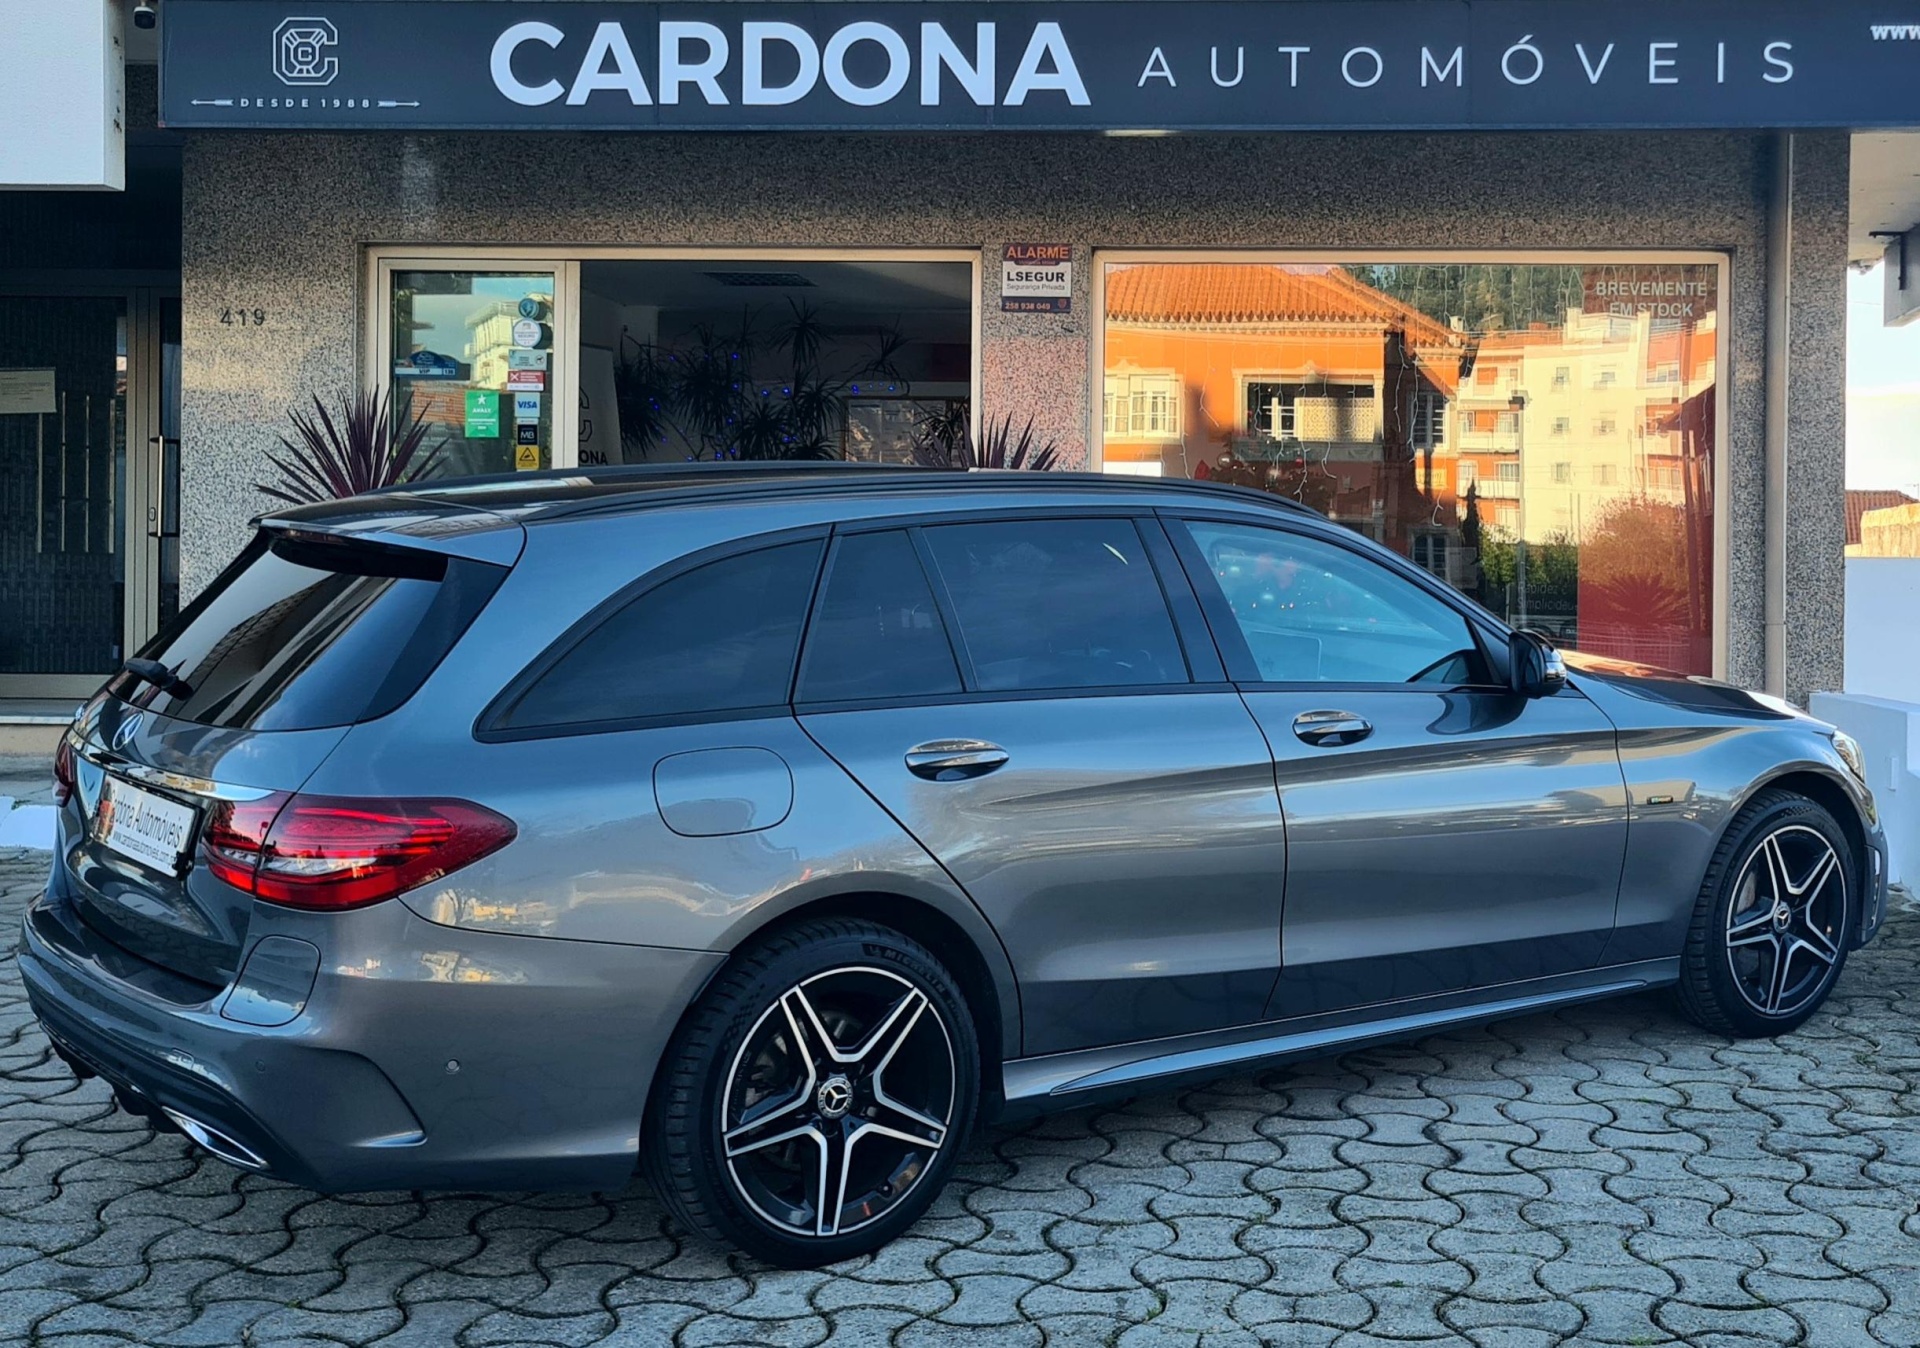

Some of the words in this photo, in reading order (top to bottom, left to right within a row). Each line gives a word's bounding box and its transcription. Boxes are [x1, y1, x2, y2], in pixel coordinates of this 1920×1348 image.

[490, 21, 1092, 106] CARDONA
[1137, 34, 1794, 88] AUTOMÓVEIS
[240, 98, 309, 108] DESDE
[321, 98, 370, 108] 1988
[1006, 245, 1069, 259] ALARME
[1006, 271, 1065, 282] LSEGUR
[1006, 283, 1040, 291] Segurança
[1596, 281, 1708, 296] BREVEMENTE
[1609, 302, 1633, 317] EM
[1637, 302, 1694, 317] STOCK
[220, 308, 265, 327] 419
[517, 401, 537, 409] VISA
[520, 431, 534, 439] MB
[132, 801, 183, 848] Automóveis
